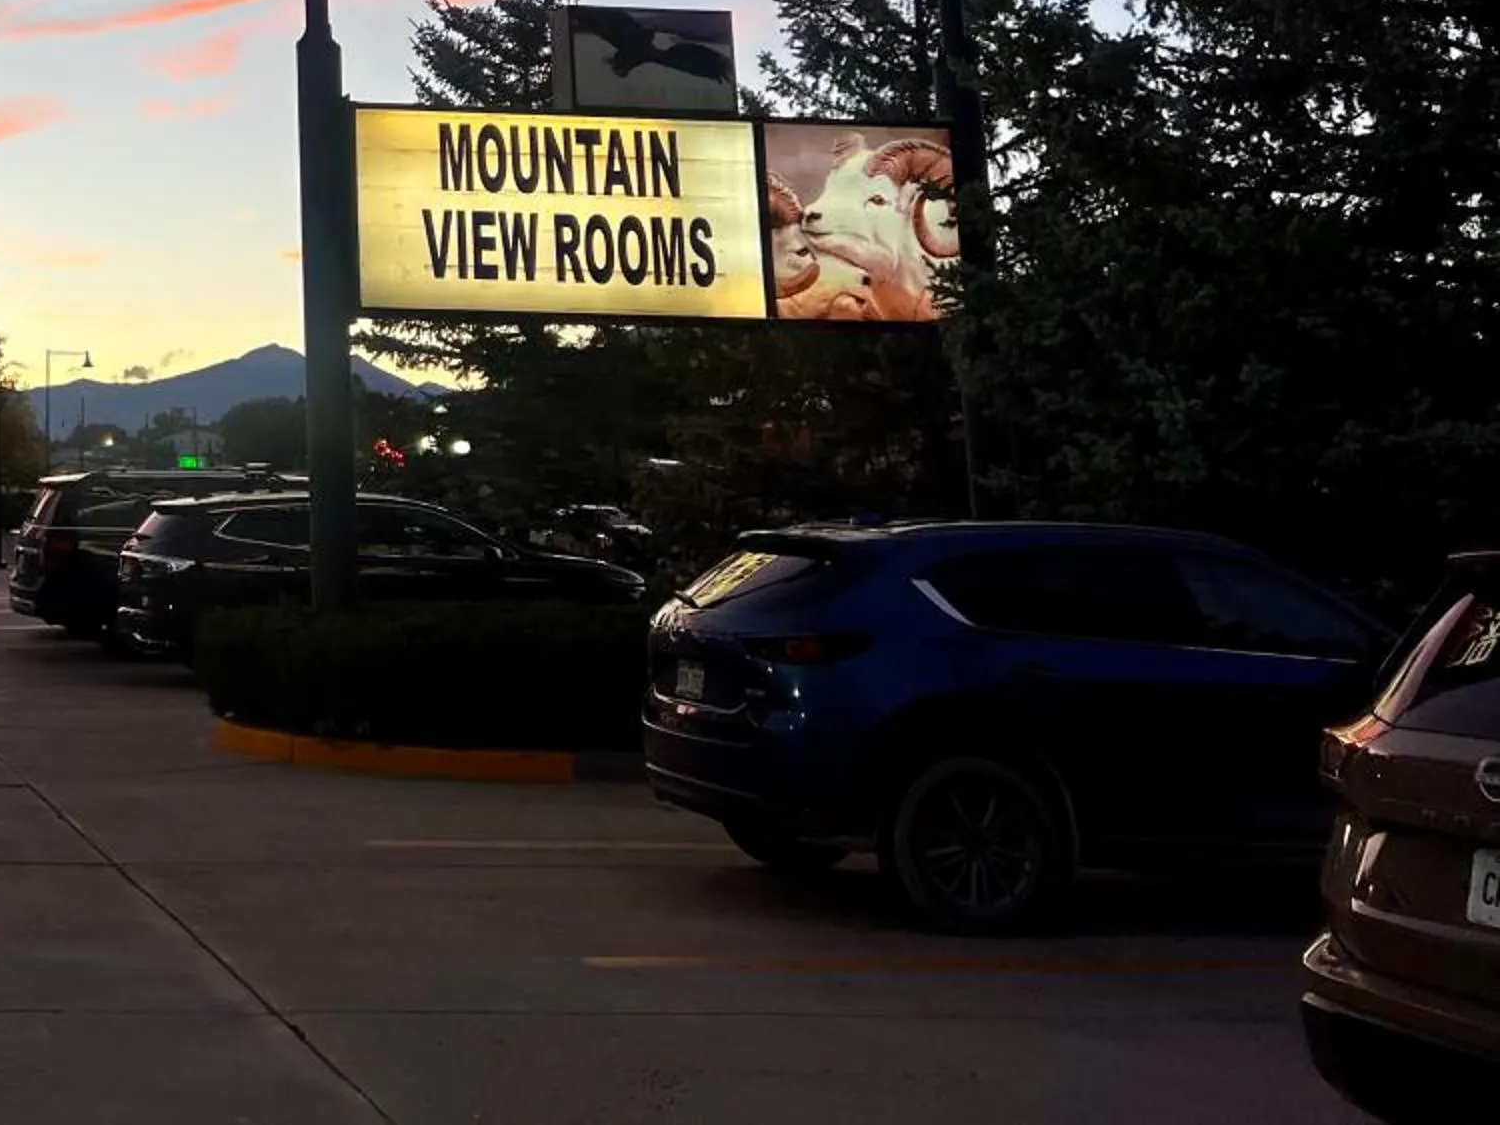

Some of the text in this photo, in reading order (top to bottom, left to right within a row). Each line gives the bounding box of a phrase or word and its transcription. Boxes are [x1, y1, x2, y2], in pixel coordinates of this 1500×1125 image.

[438, 122, 682, 198] MOUNTAIN
[422, 208, 717, 288] VIEW ROOMS
